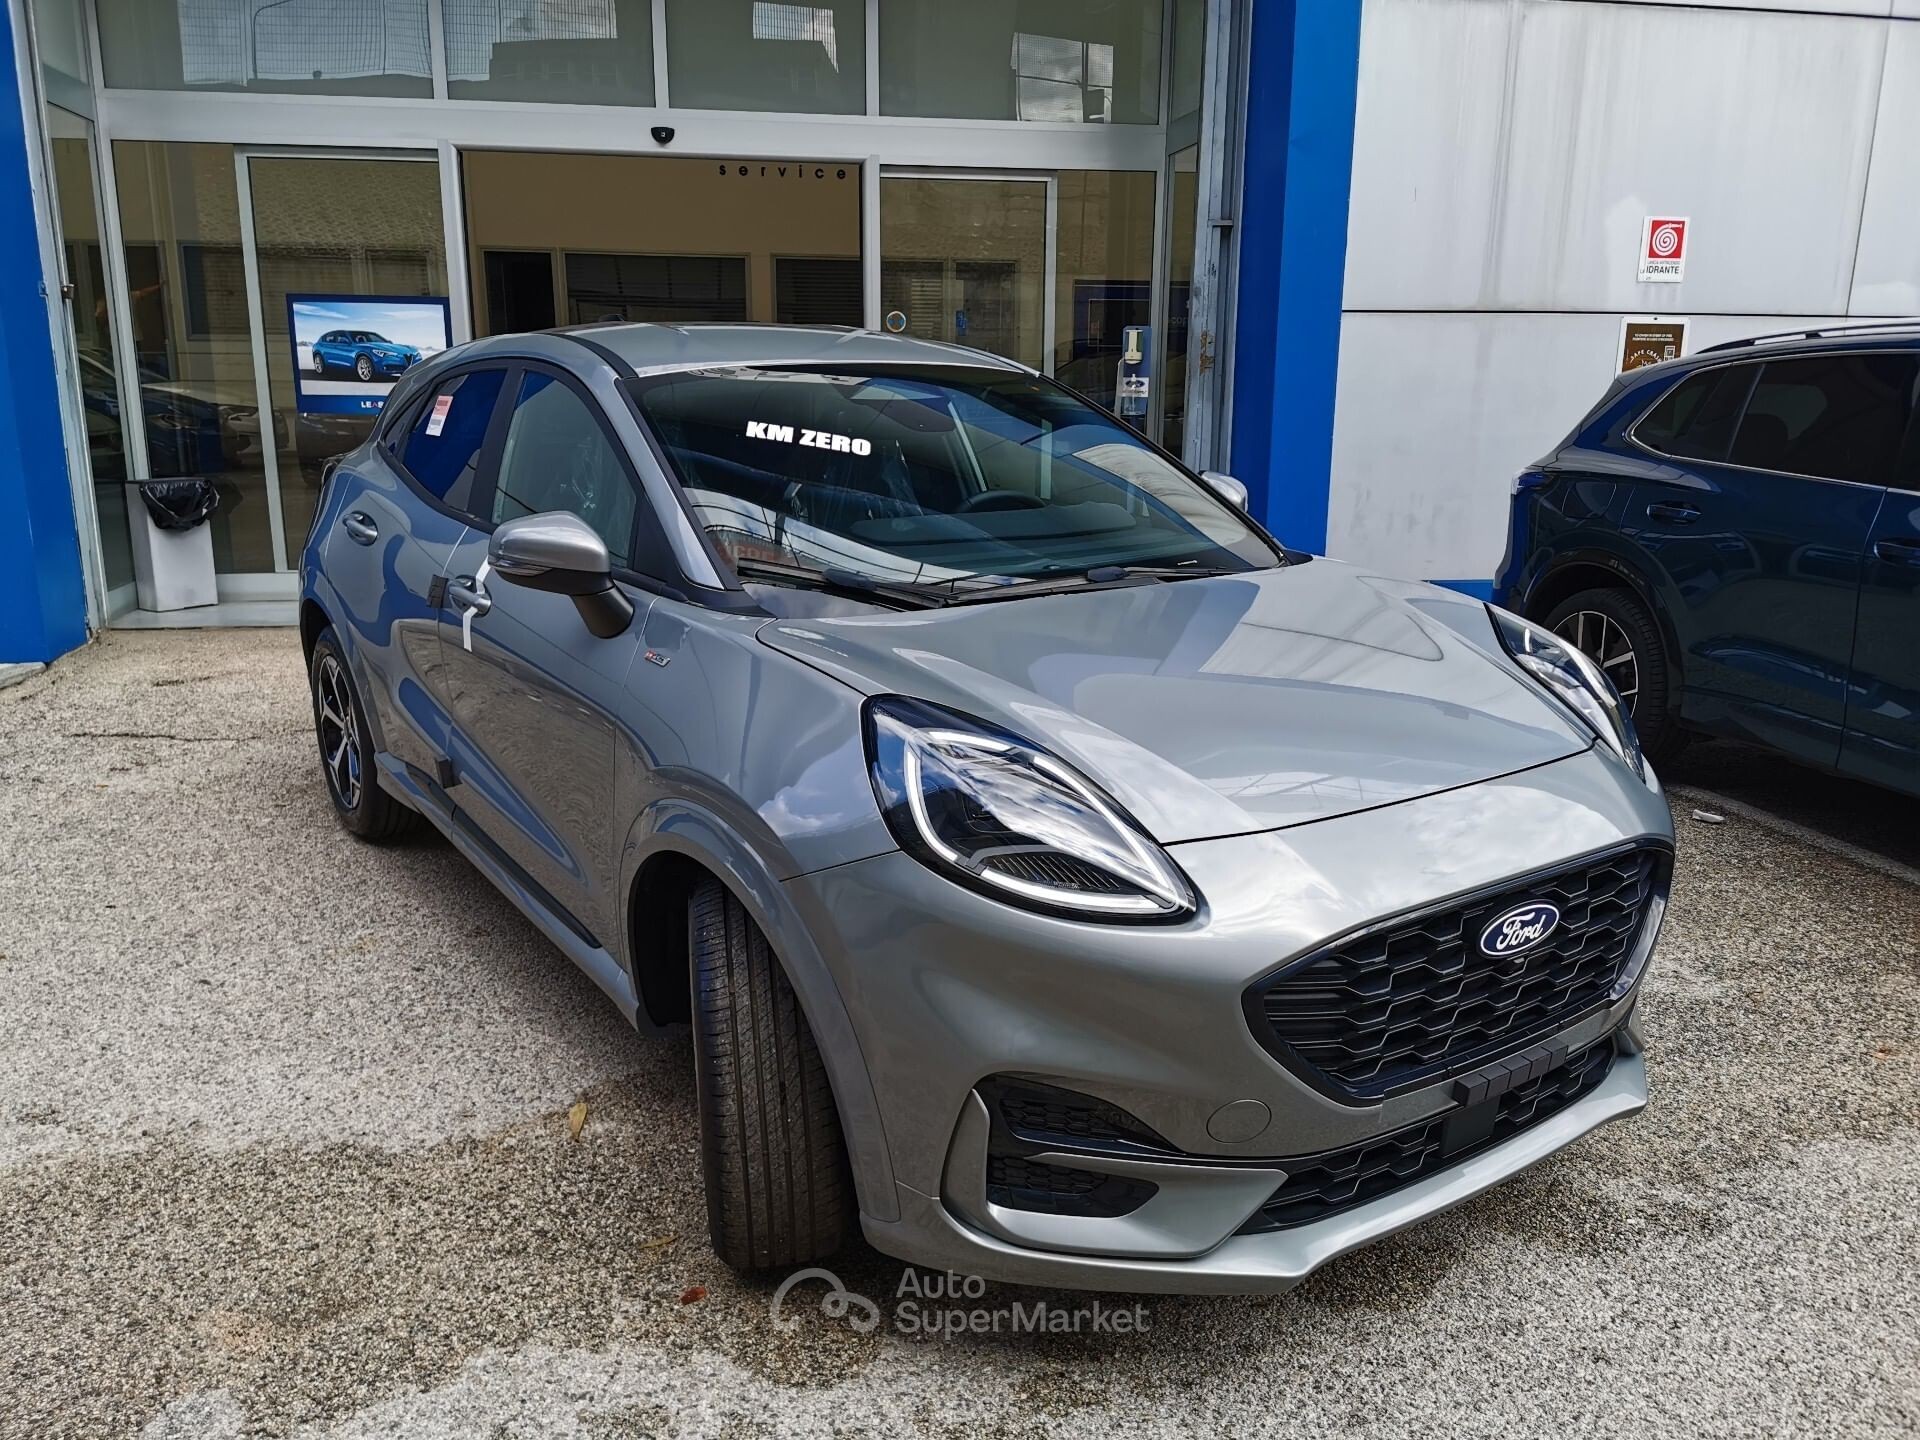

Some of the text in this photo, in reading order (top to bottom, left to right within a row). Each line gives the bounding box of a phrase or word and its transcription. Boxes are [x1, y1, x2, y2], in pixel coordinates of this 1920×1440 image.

[719, 164, 846, 180] service
[1646, 265, 1680, 275] IDRANTE
[745, 420, 871, 456] KM ZERO
[1496, 911, 1546, 950] Ford
